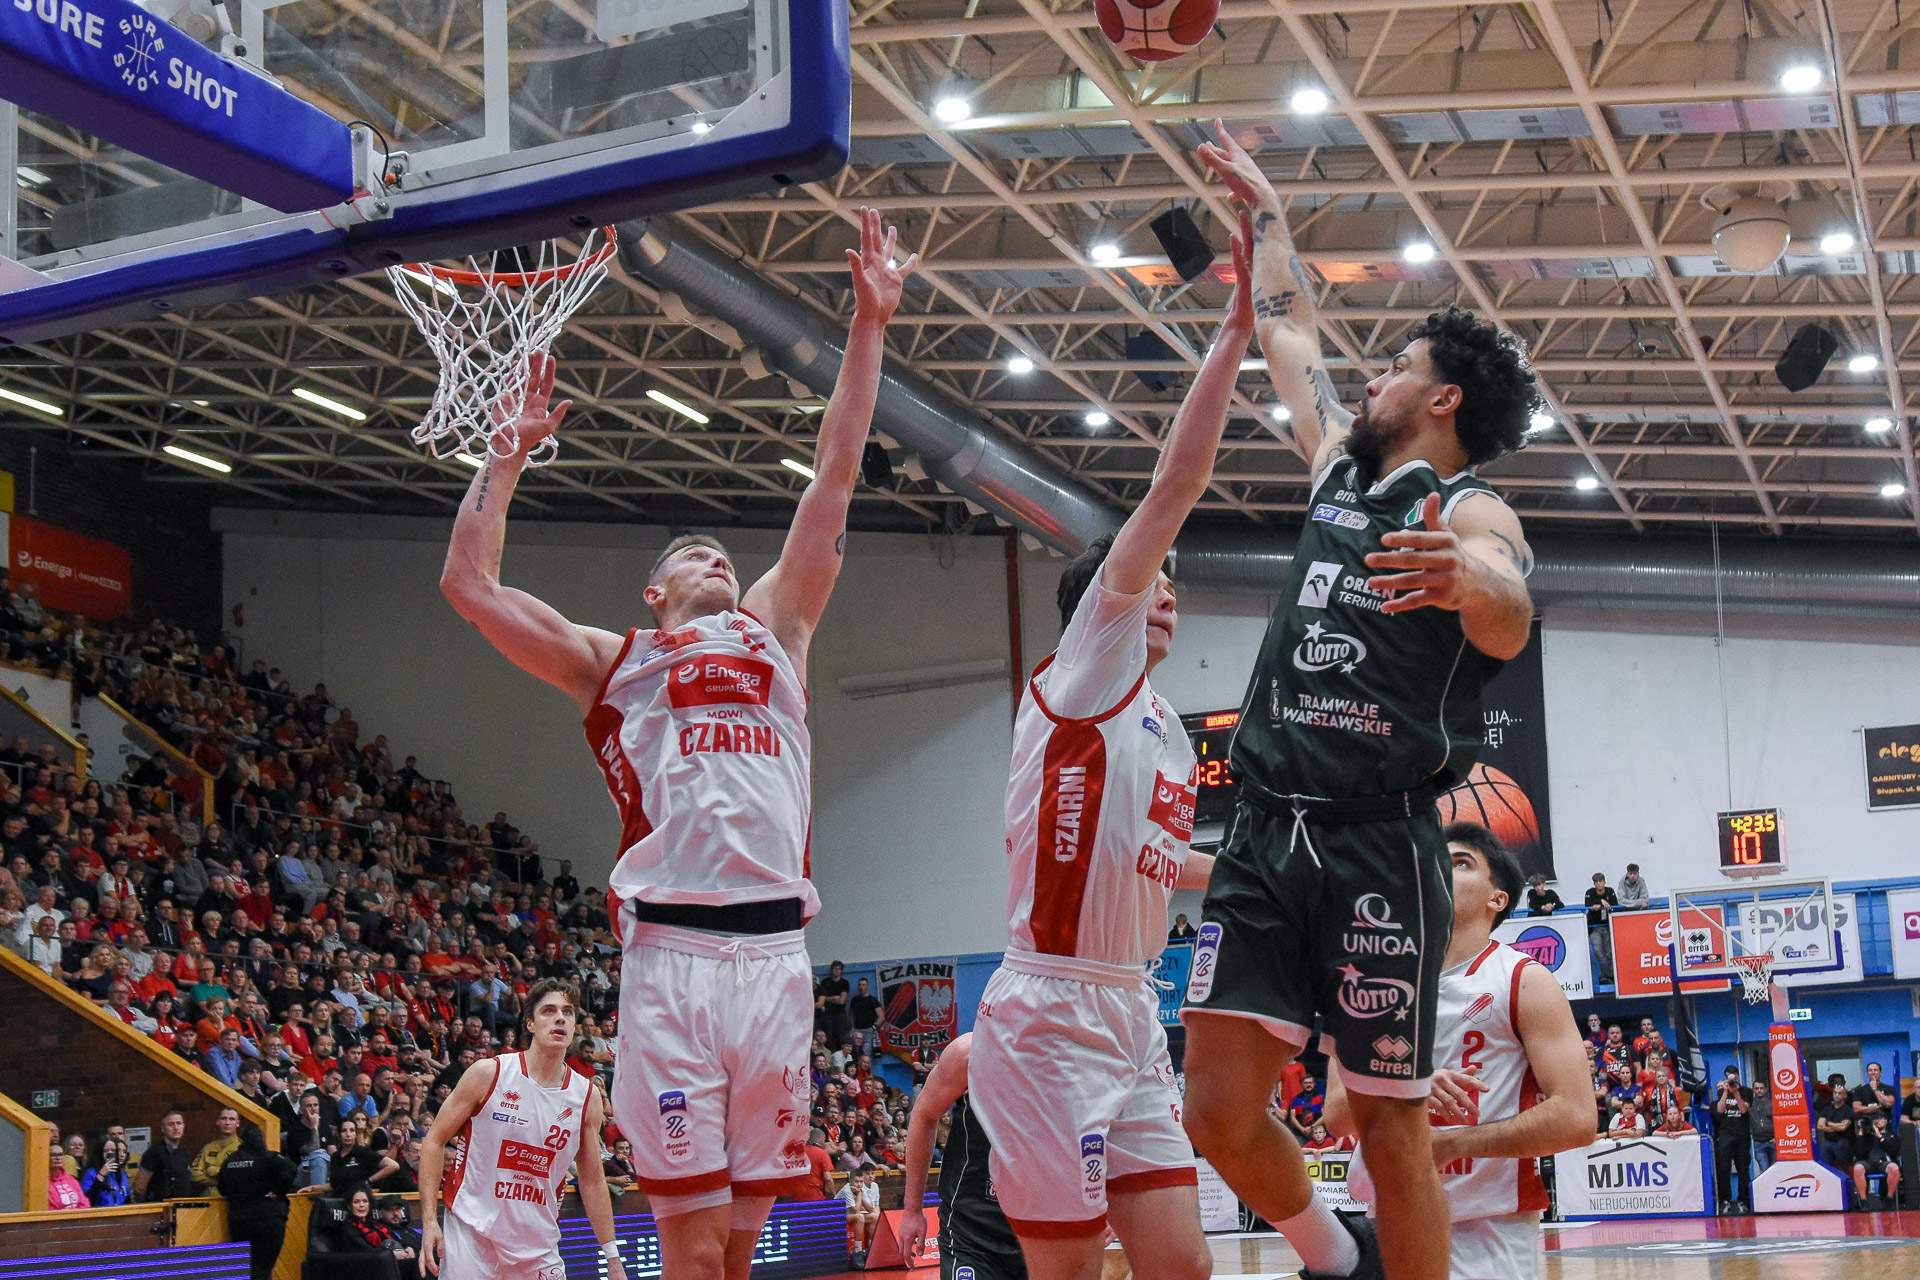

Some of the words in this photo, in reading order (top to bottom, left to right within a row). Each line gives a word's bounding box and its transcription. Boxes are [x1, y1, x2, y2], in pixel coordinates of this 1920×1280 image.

[119, 14, 165, 52] SURE
[113, 53, 160, 91] SHOT
[167, 57, 238, 118] SHOT
[34, 557, 72, 579] Energa
[1307, 642, 1350, 663] LOTTO
[705, 664, 761, 687] Energa
[705, 684, 735, 693] GRUPA
[1298, 693, 1379, 719] TRAMWAJE
[1282, 706, 1392, 736] WARSZAWSKIE
[679, 722, 781, 757] CZARNI
[1055, 766, 1087, 863] CZARNI
[1733, 832, 1761, 865] 10
[1344, 933, 1418, 955] UNIQA
[1688, 944, 1709, 952] errea
[880, 963, 953, 982] CZARNI
[1642, 976, 1671, 985] GRUPA
[1350, 986, 1399, 1010] LOTTO
[1462, 1031, 1485, 1069] 2
[1370, 1059, 1412, 1075] errea
[500, 1102, 519, 1110] errea
[662, 1098, 683, 1106] PGE
[1775, 1092, 1802, 1102] włącza
[1778, 1100, 1800, 1108] sport
[544, 1125, 571, 1150] 26
[666, 1141, 692, 1150] Basket
[1083, 1142, 1102, 1150] PGE
[1779, 1139, 1807, 1149] Energa
[671, 1148, 688, 1157] Liga
[1588, 1162, 1669, 1189] MJMS
[1590, 1195, 1671, 1211] NIERUCHOMOŚCI
[1774, 1186, 1811, 1199] PGE
